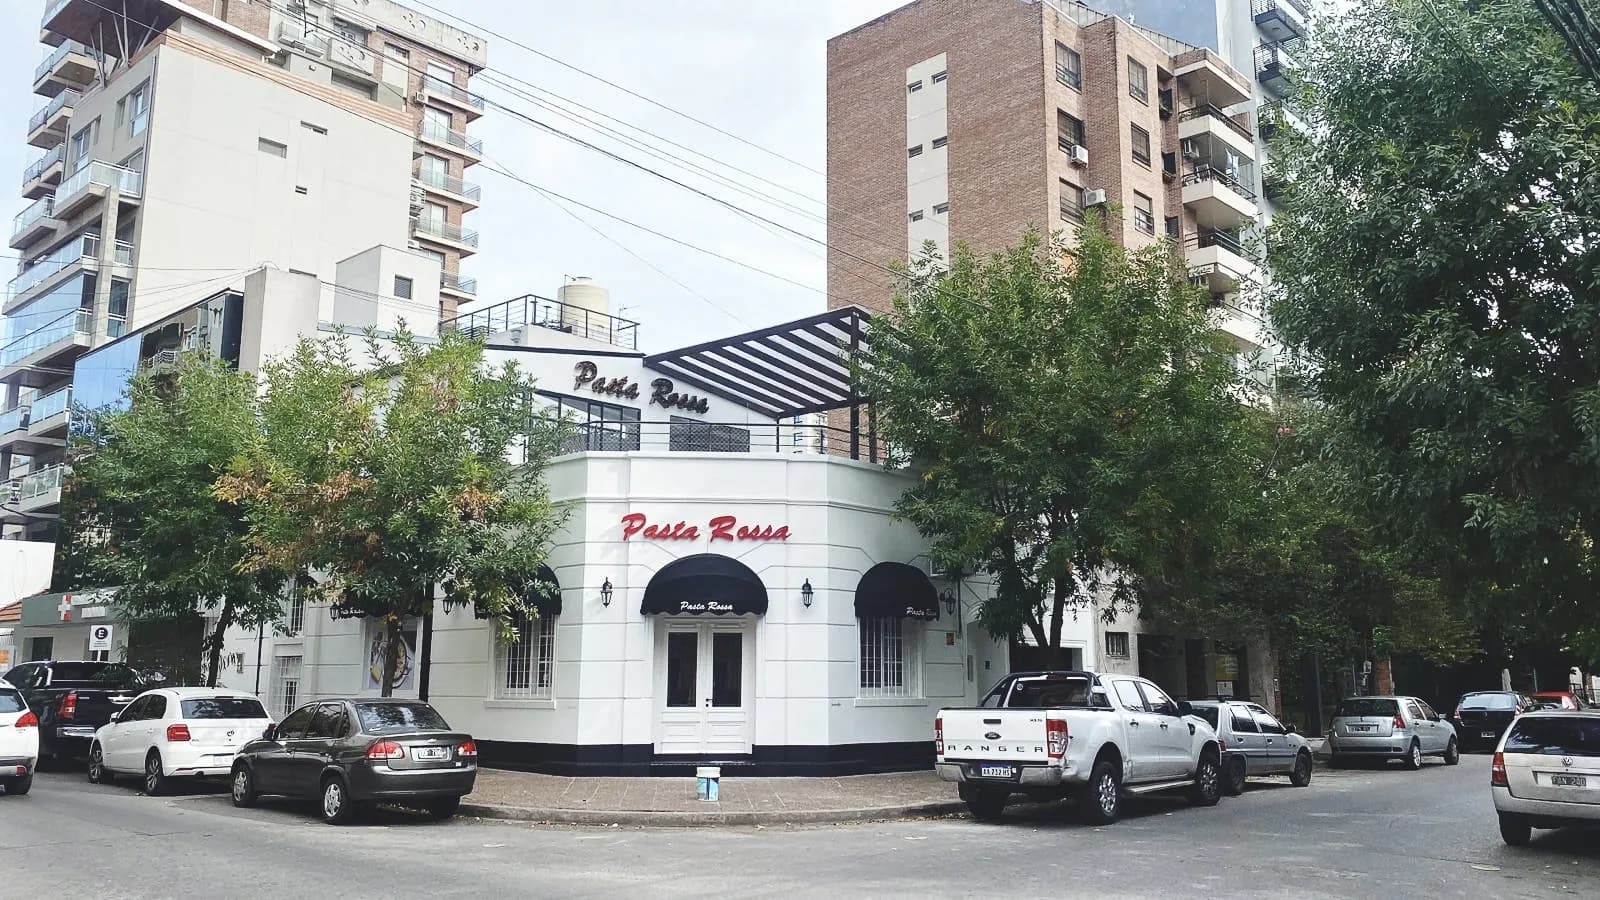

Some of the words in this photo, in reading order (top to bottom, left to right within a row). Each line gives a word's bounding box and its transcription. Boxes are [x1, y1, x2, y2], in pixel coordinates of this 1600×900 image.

[574, 361, 640, 400] Pasta
[649, 378, 710, 415] Rossa
[621, 513, 701, 542] Pasta
[708, 516, 792, 543] Rossa
[680, 601, 706, 611] Pasta
[707, 601, 733, 611] Rossa
[98, 629, 105, 638] E
[948, 744, 1043, 753] RANGER
